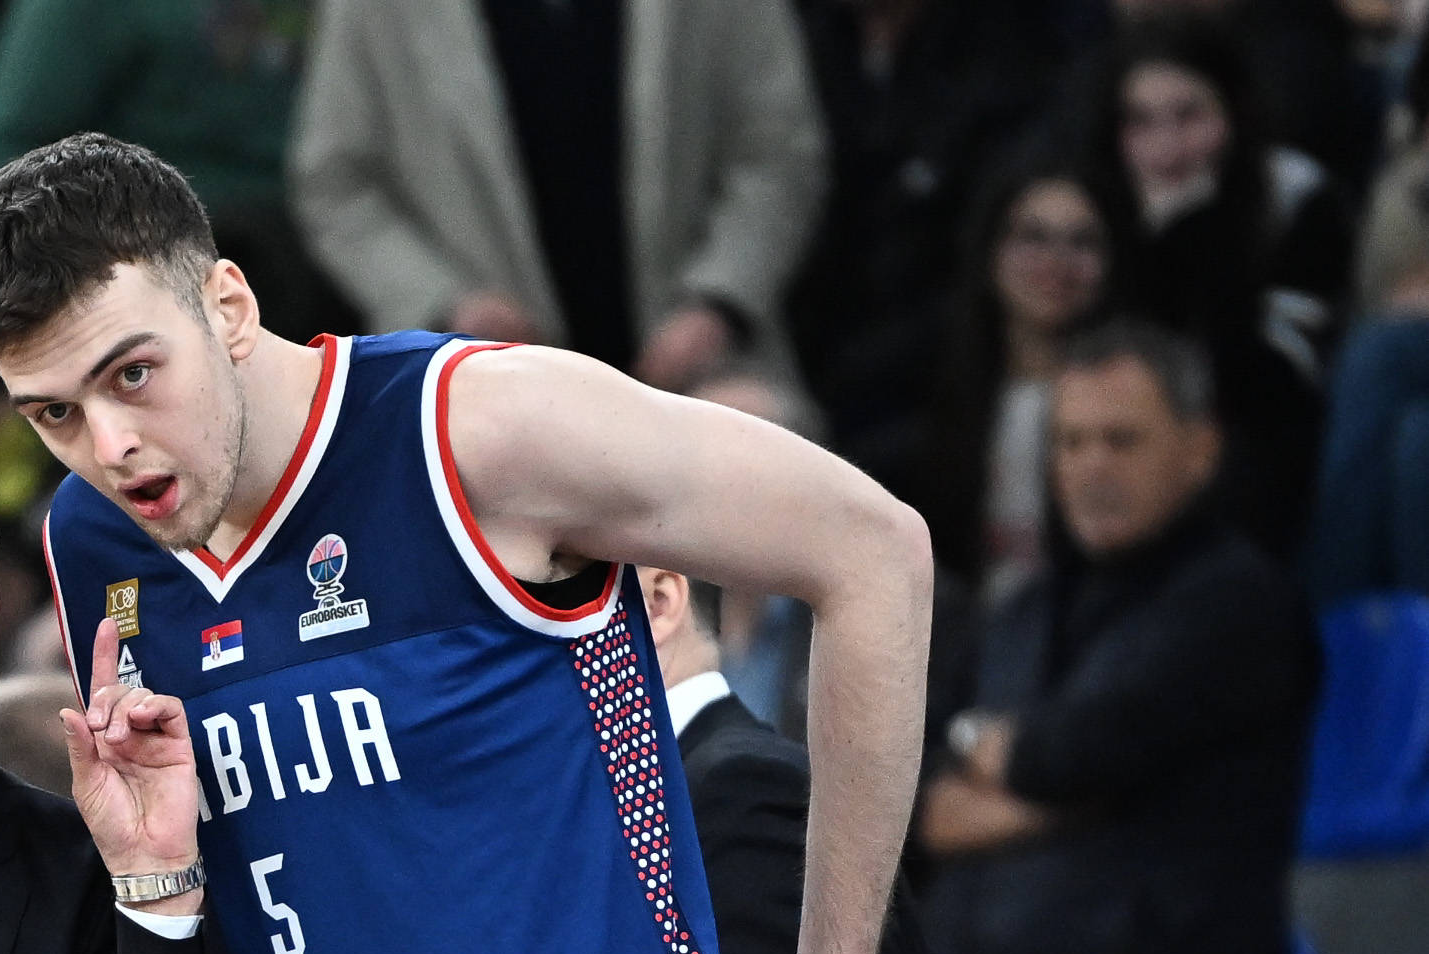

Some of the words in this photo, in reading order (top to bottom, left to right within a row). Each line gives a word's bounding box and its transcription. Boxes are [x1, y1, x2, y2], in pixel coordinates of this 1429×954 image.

[110, 586, 136, 612] 100
[301, 602, 364, 628] EUROBASKET
[196, 687, 401, 822] BIJA
